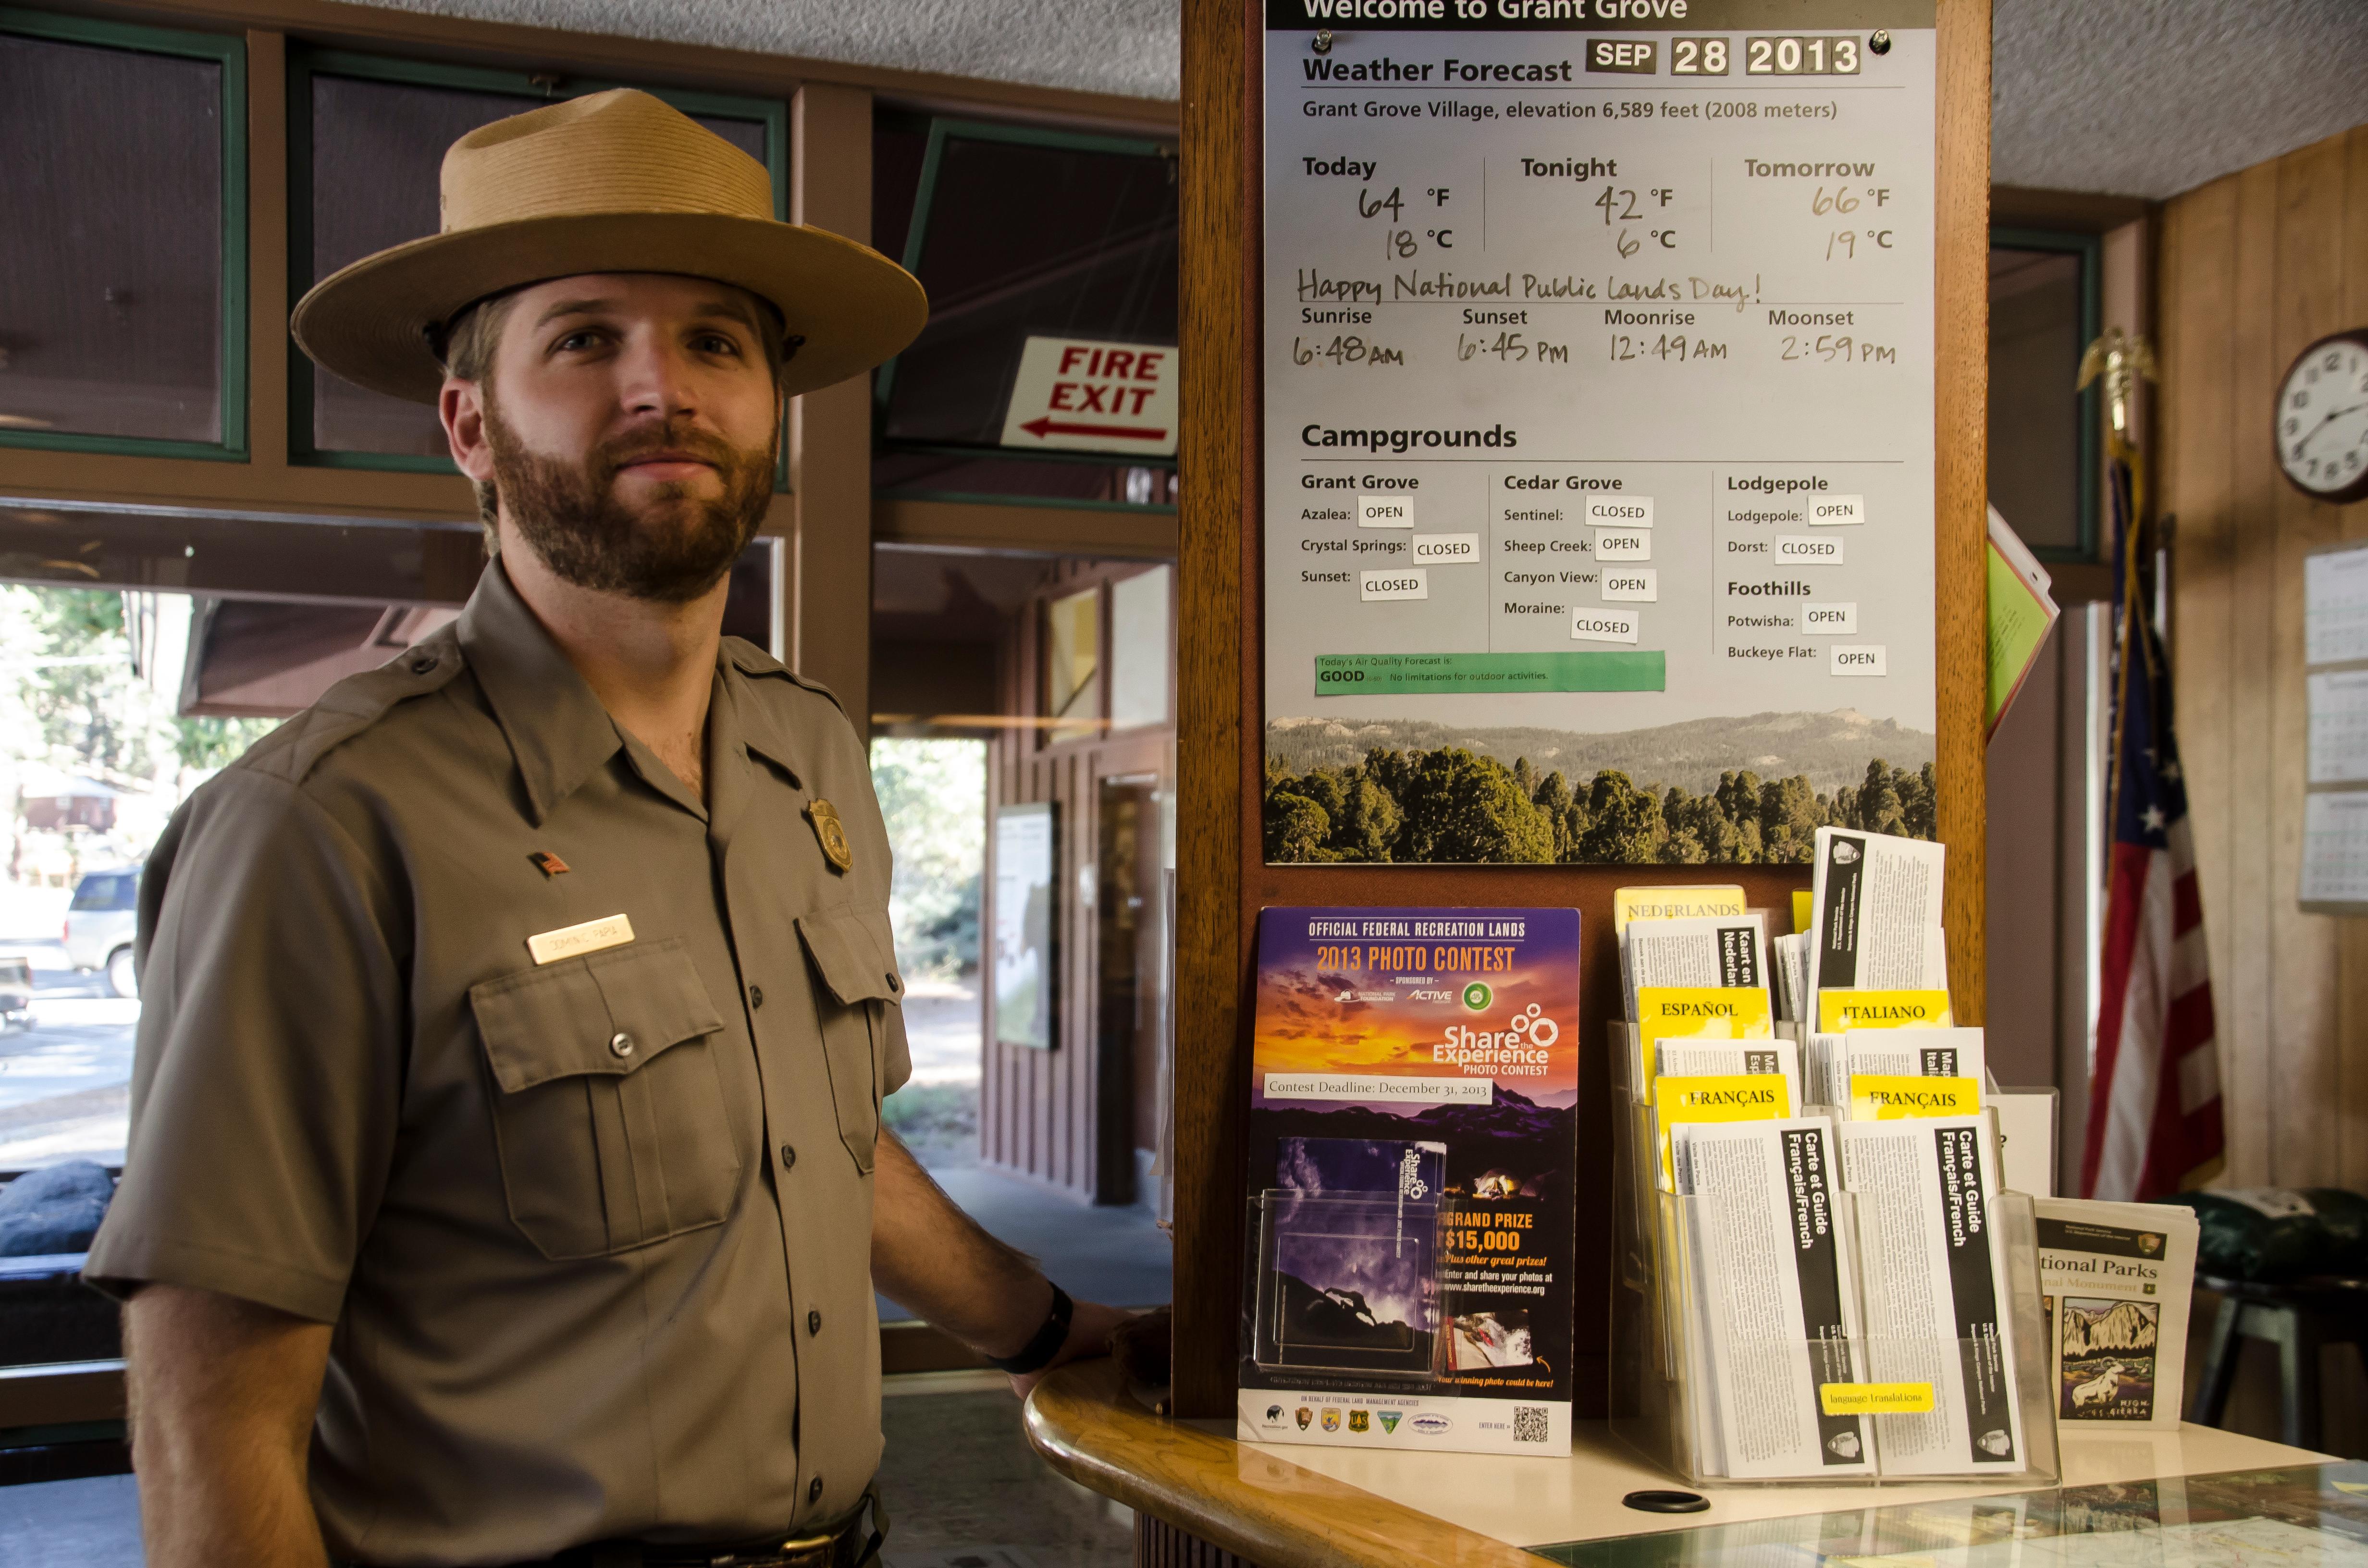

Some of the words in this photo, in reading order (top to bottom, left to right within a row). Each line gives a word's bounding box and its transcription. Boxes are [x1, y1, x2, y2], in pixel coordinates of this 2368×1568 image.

[1305, 0, 1444, 18] Welcome
[1457, 0, 1487, 19] to
[1498, 0, 1585, 19] Grant
[1596, 0, 1688, 18] Grove
[1596, 42, 1651, 66] SEP
[1675, 40, 1726, 72] 28
[1750, 39, 1858, 72] 2013
[1303, 58, 1433, 81] Weather
[1444, 60, 1572, 81] Forecast
[1303, 101, 1357, 117] Grant
[1364, 101, 1421, 117] Grove
[1428, 101, 1499, 121] Village,
[1507, 102, 1596, 117] elevation
[1603, 102, 1653, 120] 6,589
[1661, 101, 1699, 118] feet
[1705, 101, 1757, 120] (2008
[1764, 101, 1837, 120] meters)
[1303, 157, 1377, 181] Today
[1521, 157, 1617, 182] Tonight
[1745, 159, 1875, 177] Tomorrow
[1359, 187, 1404, 222] 64
[1595, 186, 1643, 225] 42
[1812, 186, 1859, 216] 66
[1387, 230, 1417, 260] 18
[1617, 228, 1640, 259] 6
[1827, 231, 1855, 260] 19
[1298, 269, 1381, 305] Happy
[1395, 270, 1511, 299] National
[1523, 273, 1596, 299] Public
[1689, 273, 1760, 313] Day!
[1301, 308, 1372, 324] Sunrise
[1463, 309, 1528, 324] Sunset
[1604, 309, 1694, 325] Moonrise
[1769, 310, 1854, 325] Moonset
[1293, 336, 1367, 366] 6:48
[1368, 345, 1404, 366] AM
[1458, 332, 1528, 361] 6:45
[1537, 342, 1568, 363] PM
[1611, 334, 1686, 361] 12:49
[1693, 340, 1727, 359] AM
[1782, 335, 1852, 362] 2:59
[1862, 344, 1895, 364] PM
[1059, 346, 1165, 381] FIRE
[1048, 382, 1156, 416] EXIT
[1301, 424, 1517, 453] Campgrounds
[1302, 475, 1356, 489] Grant
[1362, 475, 1418, 489] Grove
[1505, 476, 1560, 490] Cedar
[1566, 476, 1622, 490] Grove
[1728, 477, 1828, 494] Lodgepole
[1302, 509, 1351, 520] Azalea:
[1366, 507, 1403, 518] OPEN
[1505, 509, 1563, 521] Sentinel:
[1592, 505, 1644, 518] CLOSED
[1728, 511, 1803, 524] Lodgepole:
[1816, 505, 1853, 517] OPEN
[1302, 540, 1347, 553] Crystal
[1353, 540, 1407, 553] Springs:
[1418, 543, 1470, 555] CLOSED
[1505, 540, 1545, 554] Sheep
[1550, 540, 1591, 552] Creek:
[1603, 538, 1639, 550] OPEN
[1728, 541, 1768, 552] Dorst:
[1782, 543, 1834, 555] CLOSED
[1302, 571, 1351, 582] Sunset:
[1366, 579, 1418, 591] CLOSED
[1505, 572, 1556, 586] Canyon
[1560, 571, 1598, 583] View:
[1609, 579, 1645, 590] OPEN
[1728, 581, 1811, 596] Foothills
[1505, 602, 1565, 614] Moraine:
[1577, 620, 1629, 634] CLOSED
[1728, 615, 1794, 626] Potwisha:
[1809, 612, 1845, 623] OPEN
[1320, 658, 1353, 667] Today's
[1371, 658, 1402, 667] Quality
[1728, 647, 1783, 660] Buckeye
[1788, 647, 1816, 658] Flat:
[1838, 653, 1875, 664] OPEN
[1320, 671, 1364, 682] GOOD
[1454, 673, 1466, 681] for
[1628, 904, 1740, 917] NEDERLANDS
[1309, 922, 1358, 937] OFFICIAL
[1363, 922, 1410, 937] FEDERAL
[1415, 923, 1484, 937] RECREATION
[1489, 924, 1525, 937] LANDS
[1739, 931, 1751, 965] Kaart
[1318, 946, 1360, 971] 2013
[1369, 947, 1427, 971] PHOTO
[1434, 947, 1515, 971] CONTEST
[1742, 968, 1751, 983] en
[1407, 990, 1453, 1000] ACTIVE
[1661, 1000, 1738, 1017] ESPAÑOL
[1843, 1005, 1926, 1019] ITALIANO
[1445, 1025, 1519, 1049] Share
[1433, 1045, 1548, 1067] Experience
[1464, 1065, 1497, 1075] PHOTO
[1501, 1065, 1548, 1076] CONTEST
[1270, 1081, 1314, 1092] Contest
[1319, 1082, 1375, 1094] Deadline:
[1379, 1084, 1440, 1094] December
[1443, 1085, 1458, 1097] 31,
[1462, 1087, 1487, 1097] 2013
[1690, 1090, 1774, 1106] FRANÇAIS
[1870, 1091, 1956, 1109] FRANÇAIS
[1805, 1132, 1819, 1172] Carte
[1959, 1131, 1973, 1170] Carte
[1404, 1149, 1413, 1195] Experience
[1410, 1153, 1420, 1184] Share
[1810, 1174, 1822, 1190] et
[1942, 1132, 1966, 1247] Français/French
[1963, 1172, 1976, 1188] et
[1788, 1133, 1813, 1249] Français/French
[1447, 1212, 1490, 1227] GRAND
[1495, 1213, 1532, 1228] PRIZE
[1813, 1191, 1828, 1235] Guide
[1966, 1190, 1982, 1233] Guide
[1445, 1230, 1519, 1253] $15,000
[1445, 1253, 1464, 1263] Plus
[1466, 1255, 1488, 1264] other
[1491, 1256, 1514, 1267] great
[2104, 1260, 2158, 1279] Parks
[1445, 1269, 1462, 1279] Enter
[1465, 1270, 1478, 1280] and
[1480, 1271, 1499, 1280] share
[1502, 1272, 1517, 1282] your
[1519, 1272, 1542, 1283] photos
[1545, 1273, 1552, 1282] at
[1485, 1378, 1503, 1387] photo
[1830, 1394, 1867, 1404] language
[1871, 1393, 1923, 1403] translations
